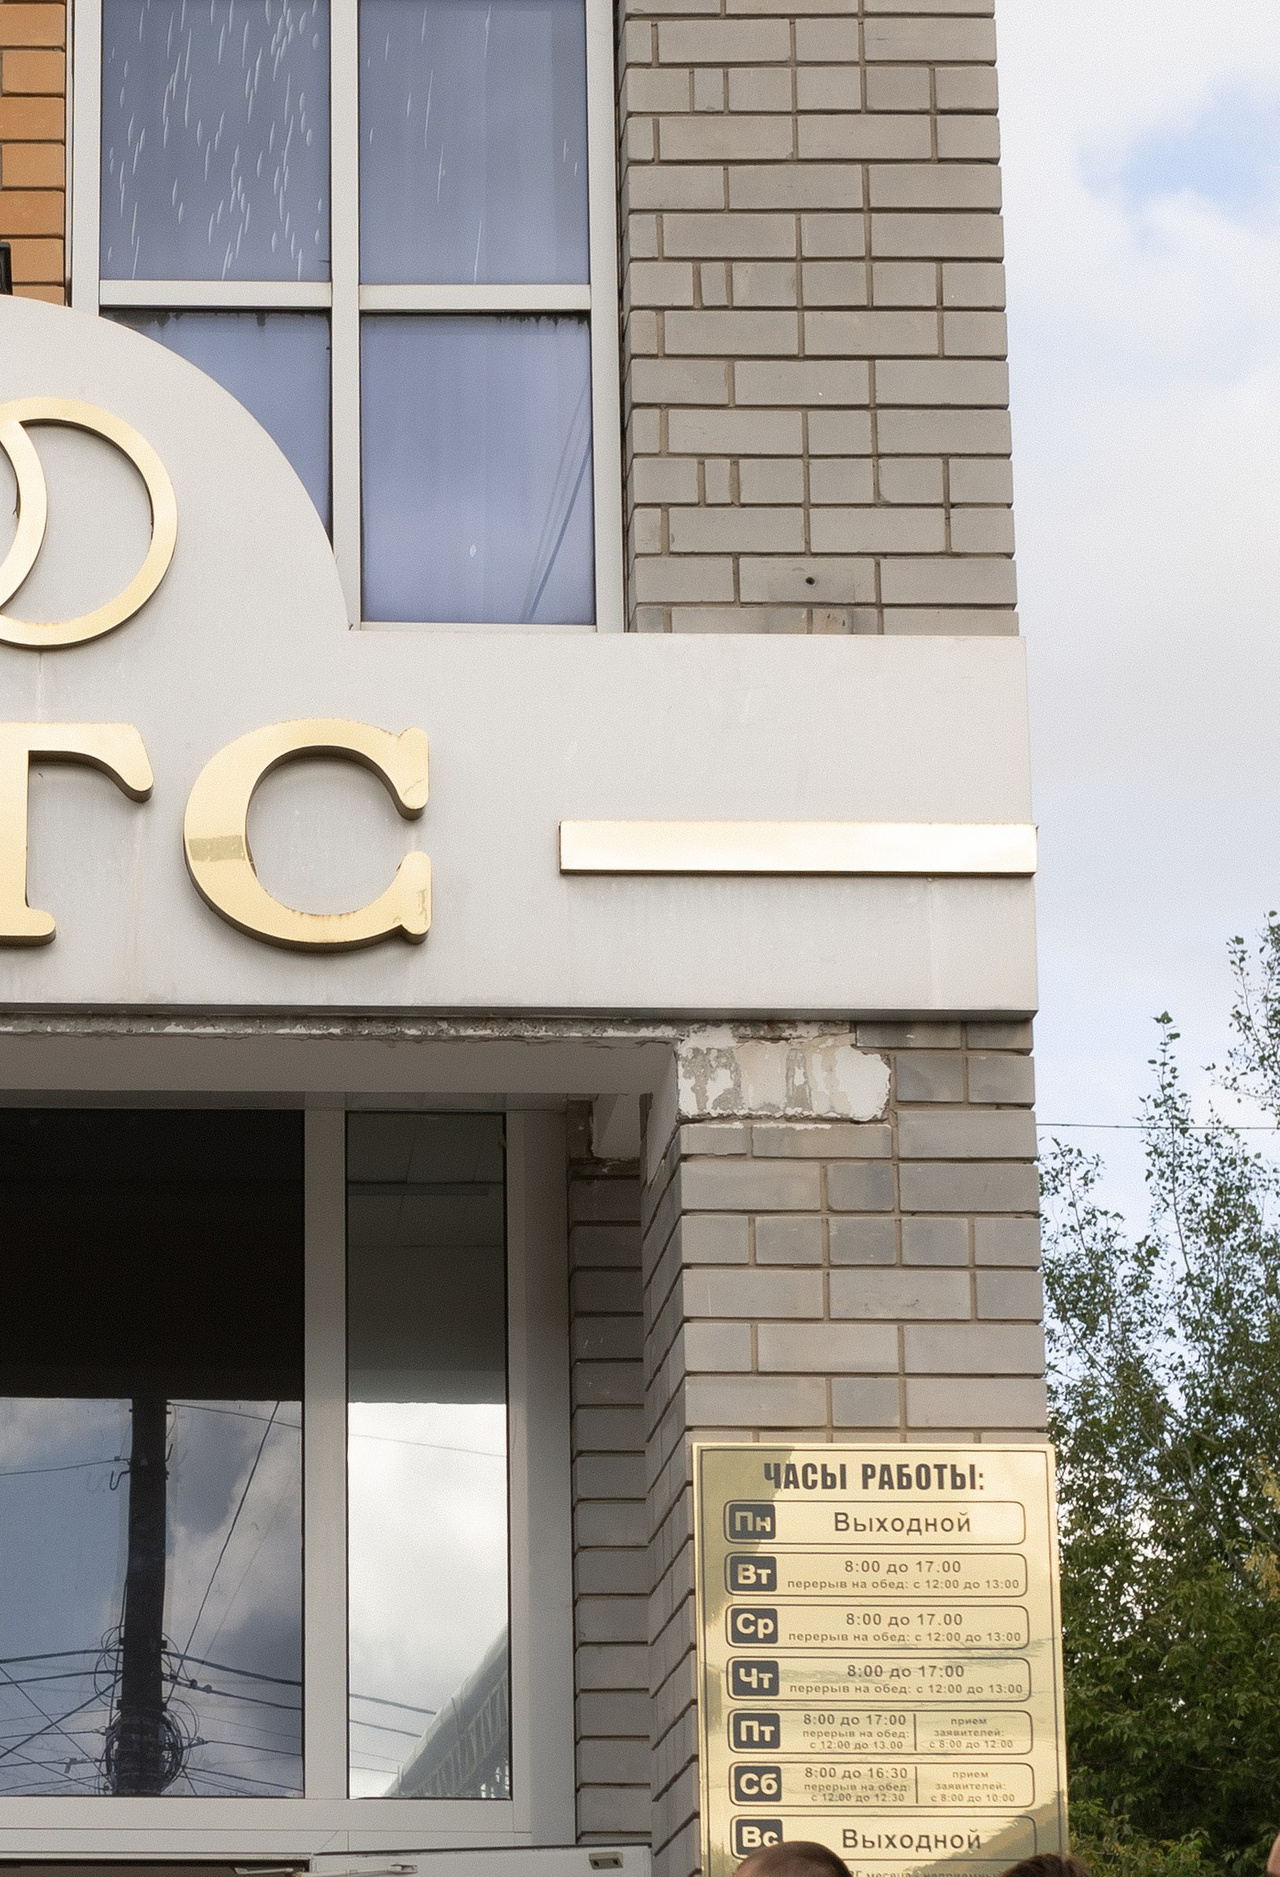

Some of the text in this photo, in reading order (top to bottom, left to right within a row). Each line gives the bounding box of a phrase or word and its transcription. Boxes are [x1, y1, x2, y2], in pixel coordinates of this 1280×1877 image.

[763, 1462, 985, 1491] ЧАСЫ РАБОТЫ:
[734, 1511, 971, 1534] Пн Выходной
[736, 1563, 772, 1585] Вт
[844, 1560, 880, 1573] 8:00
[886, 1563, 909, 1575] до
[787, 1579, 1019, 1591] перерыв на обед: с 12:00 до 13:00
[736, 1612, 774, 1639] Ср
[846, 1613, 882, 1626] 8:00
[888, 1616, 910, 1627] до
[788, 1632, 1020, 1643] перерыв на обед: с 12:00 до 13:00
[738, 1664, 964, 1690] Чт 8:00 до 17:00
[789, 1685, 850, 1695] перерыв
[874, 1684, 911, 1694] обед:
[929, 1684, 962, 1694] 12:00
[967, 1686, 983, 1694] до
[989, 1684, 1023, 1694] 13:00
[803, 1714, 906, 1726] 8:00 до 17:00
[950, 1718, 988, 1727] прием
[740, 1720, 775, 1742] Пт
[802, 1730, 856, 1739] перерыв
[876, 1729, 910, 1739] обед:
[821, 1740, 851, 1749] 12:00
[854, 1742, 869, 1750] до
[929, 1741, 935, 1749] с
[966, 1741, 980, 1749] до
[805, 1767, 908, 1780] 8:00 до 16:30
[952, 1771, 989, 1780] прием
[739, 1772, 779, 1796] Сб
[804, 1784, 857, 1792] перерыв
[822, 1793, 852, 1802] 12:00
[986, 1794, 1015, 1802] 10:00
[741, 1826, 981, 1851] Вс Выходной
